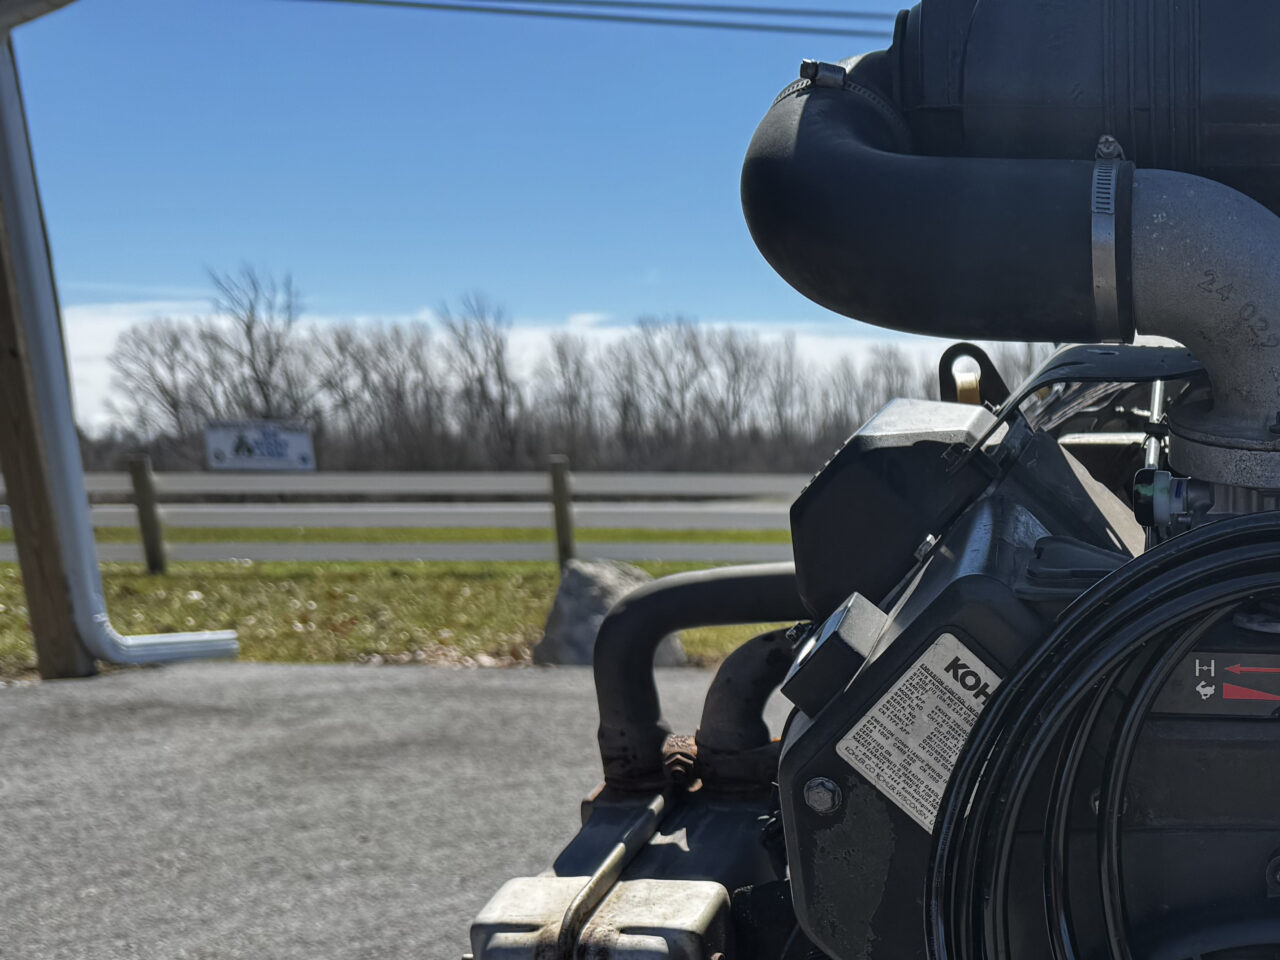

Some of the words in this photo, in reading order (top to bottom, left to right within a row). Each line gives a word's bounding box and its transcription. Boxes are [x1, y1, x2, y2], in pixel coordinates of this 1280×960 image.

[1198, 269, 1235, 301] 24
[900, 682, 915, 695] TYPE
[904, 678, 925, 697] FAMILY
[911, 671, 929, 687] STAGE
[919, 662, 946, 686] EMISSION
[943, 684, 969, 707] CONTROL
[892, 690, 908, 704] SPEC
[896, 686, 915, 703] MODEL
[915, 667, 929, 680] THIS
[927, 678, 947, 696] ENGINE
[945, 694, 964, 711] MEETS
[884, 698, 902, 714] BUILD
[900, 712, 915, 725] DATE
[888, 694, 908, 712] SERIAL
[865, 718, 878, 730] EPA
[885, 714, 900, 727] TYPE
[889, 709, 910, 728] FAMILY
[861, 723, 874, 734] ECS
[857, 726, 885, 751] CERTIFIED
[883, 748, 893, 757] ON
[897, 761, 925, 785] UNLEADED
[869, 714, 895, 737] EMISSION
[893, 735, 925, 764] COMPLIANCE
[923, 762, 944, 780] PERIOD
[850, 734, 886, 765] MAINTENANCE
[885, 764, 902, 779] SPECS
[901, 777, 913, 789] AND
[854, 730, 872, 747] REFER
[870, 744, 880, 753] TO
[900, 770, 922, 790] MANUAL
[920, 788, 933, 799] FOR
[843, 745, 866, 765] KOHLER
[893, 789, 929, 820] WISCONSIN
